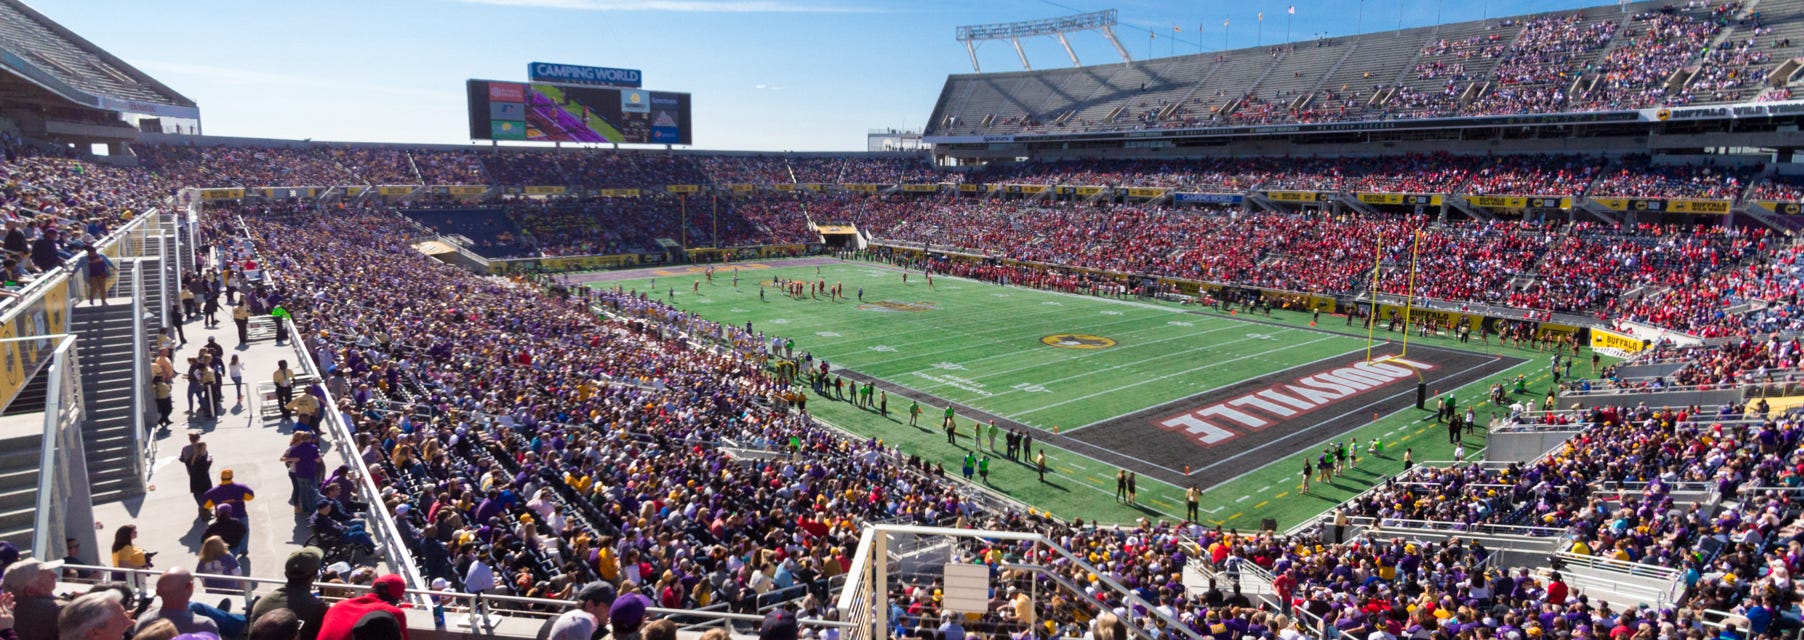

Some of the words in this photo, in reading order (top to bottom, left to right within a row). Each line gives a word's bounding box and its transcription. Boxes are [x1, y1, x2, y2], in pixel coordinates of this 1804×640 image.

[537, 64, 594, 79] CAMPING
[595, 68, 638, 82] WORLD
[1672, 108, 1727, 118] BUFFALO
[1733, 106, 1763, 115] WILD
[1410, 309, 1449, 319] BUFFALO
[1607, 336, 1637, 350] BUFFALO
[1160, 353, 1435, 445] LOUISVILLE
